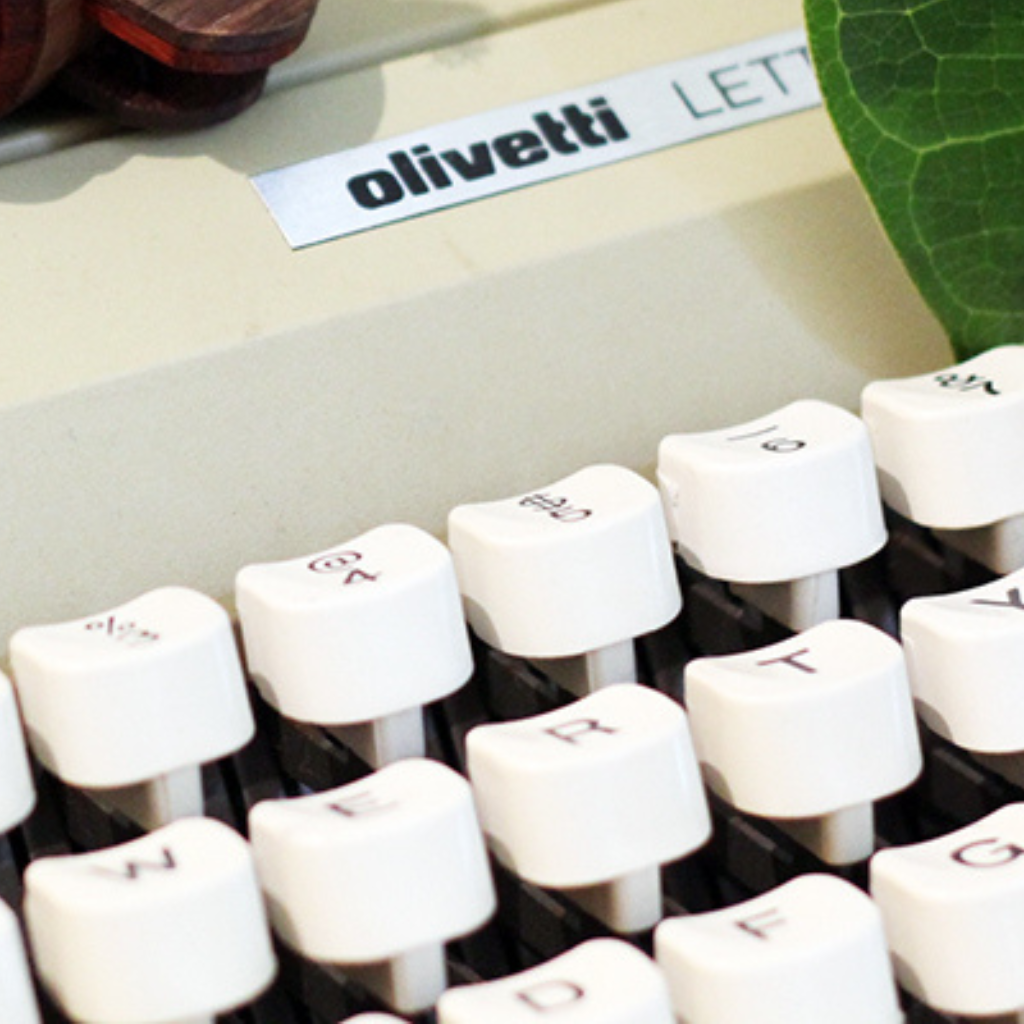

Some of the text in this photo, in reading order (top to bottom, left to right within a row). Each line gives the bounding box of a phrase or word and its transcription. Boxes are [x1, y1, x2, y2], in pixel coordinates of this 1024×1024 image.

[347, 96, 631, 210] olivetti
[756, 647, 817, 674] T
[542, 718, 617, 745] R
[325, 789, 399, 819] E
[88, 847, 176, 881] W
[950, 837, 1024, 869] G
[733, 907, 788, 941] F
[516, 979, 585, 1013] D
